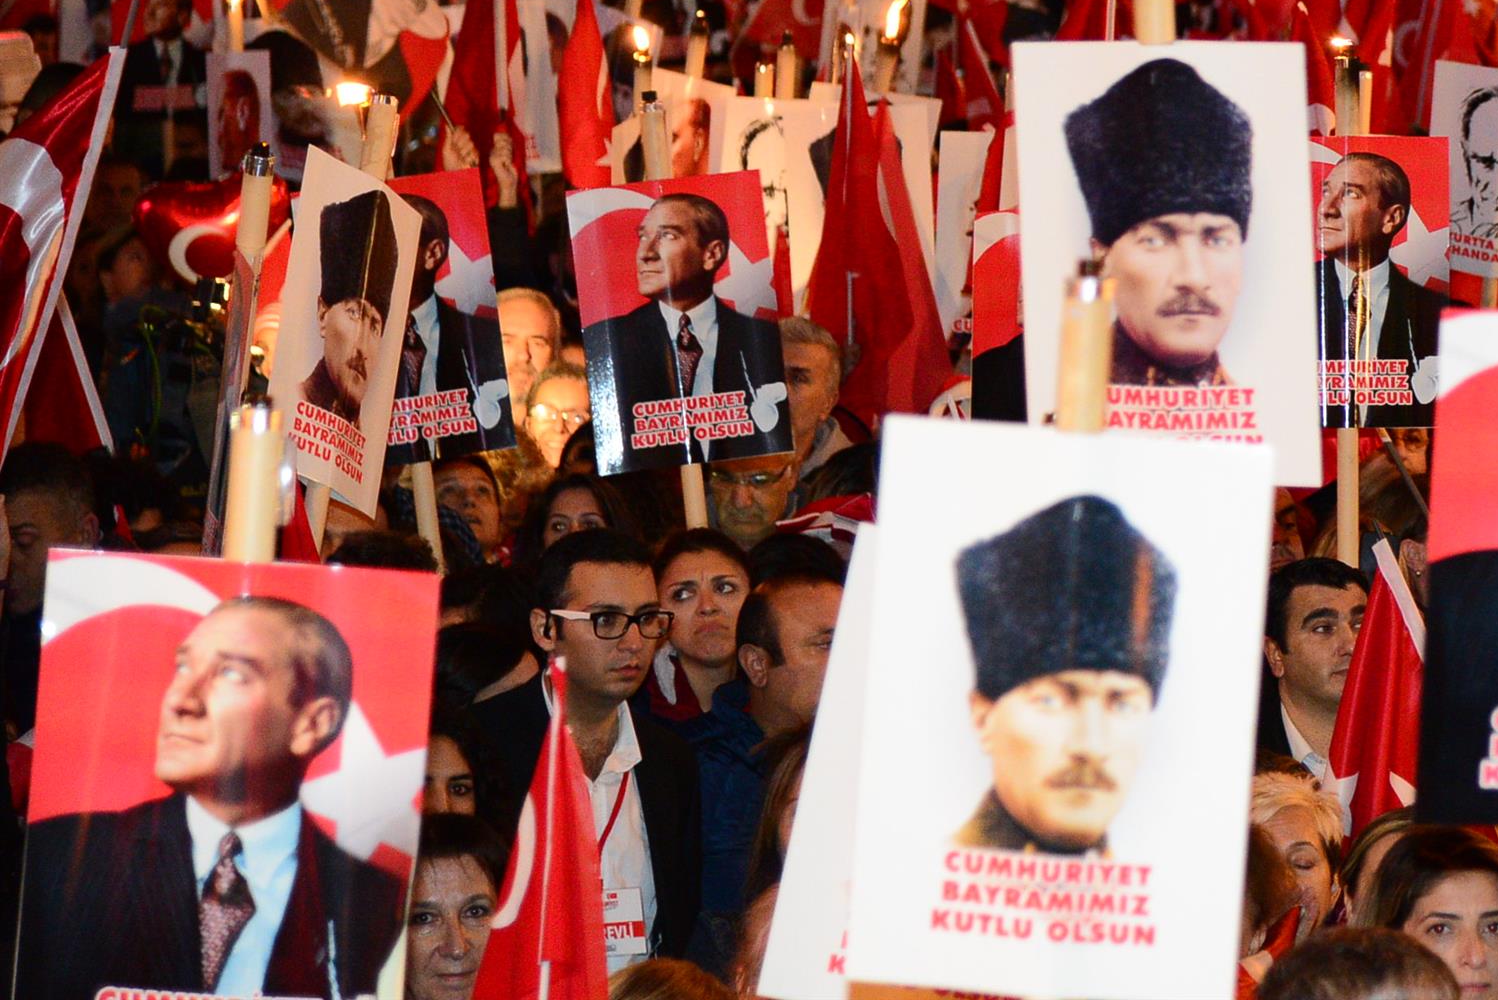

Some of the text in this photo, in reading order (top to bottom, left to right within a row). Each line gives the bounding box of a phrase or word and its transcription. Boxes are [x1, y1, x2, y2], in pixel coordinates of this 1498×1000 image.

[1106, 386, 1255, 407] UMHURİYET
[1356, 391, 1412, 404] OLSUN
[422, 420, 477, 439] OLSUN
[636, 406, 748, 432] BAYRAMIMIZ
[1108, 410, 1258, 431] AYRAMIMIZ
[293, 417, 365, 467] BAYRAMIMIZ
[632, 421, 753, 447] KUTLU OLSUN
[334, 455, 364, 485] OLSUN
[942, 881, 1149, 916] BAYRAMIMIZ
[930, 909, 1156, 946] KUTLU OLSUN
